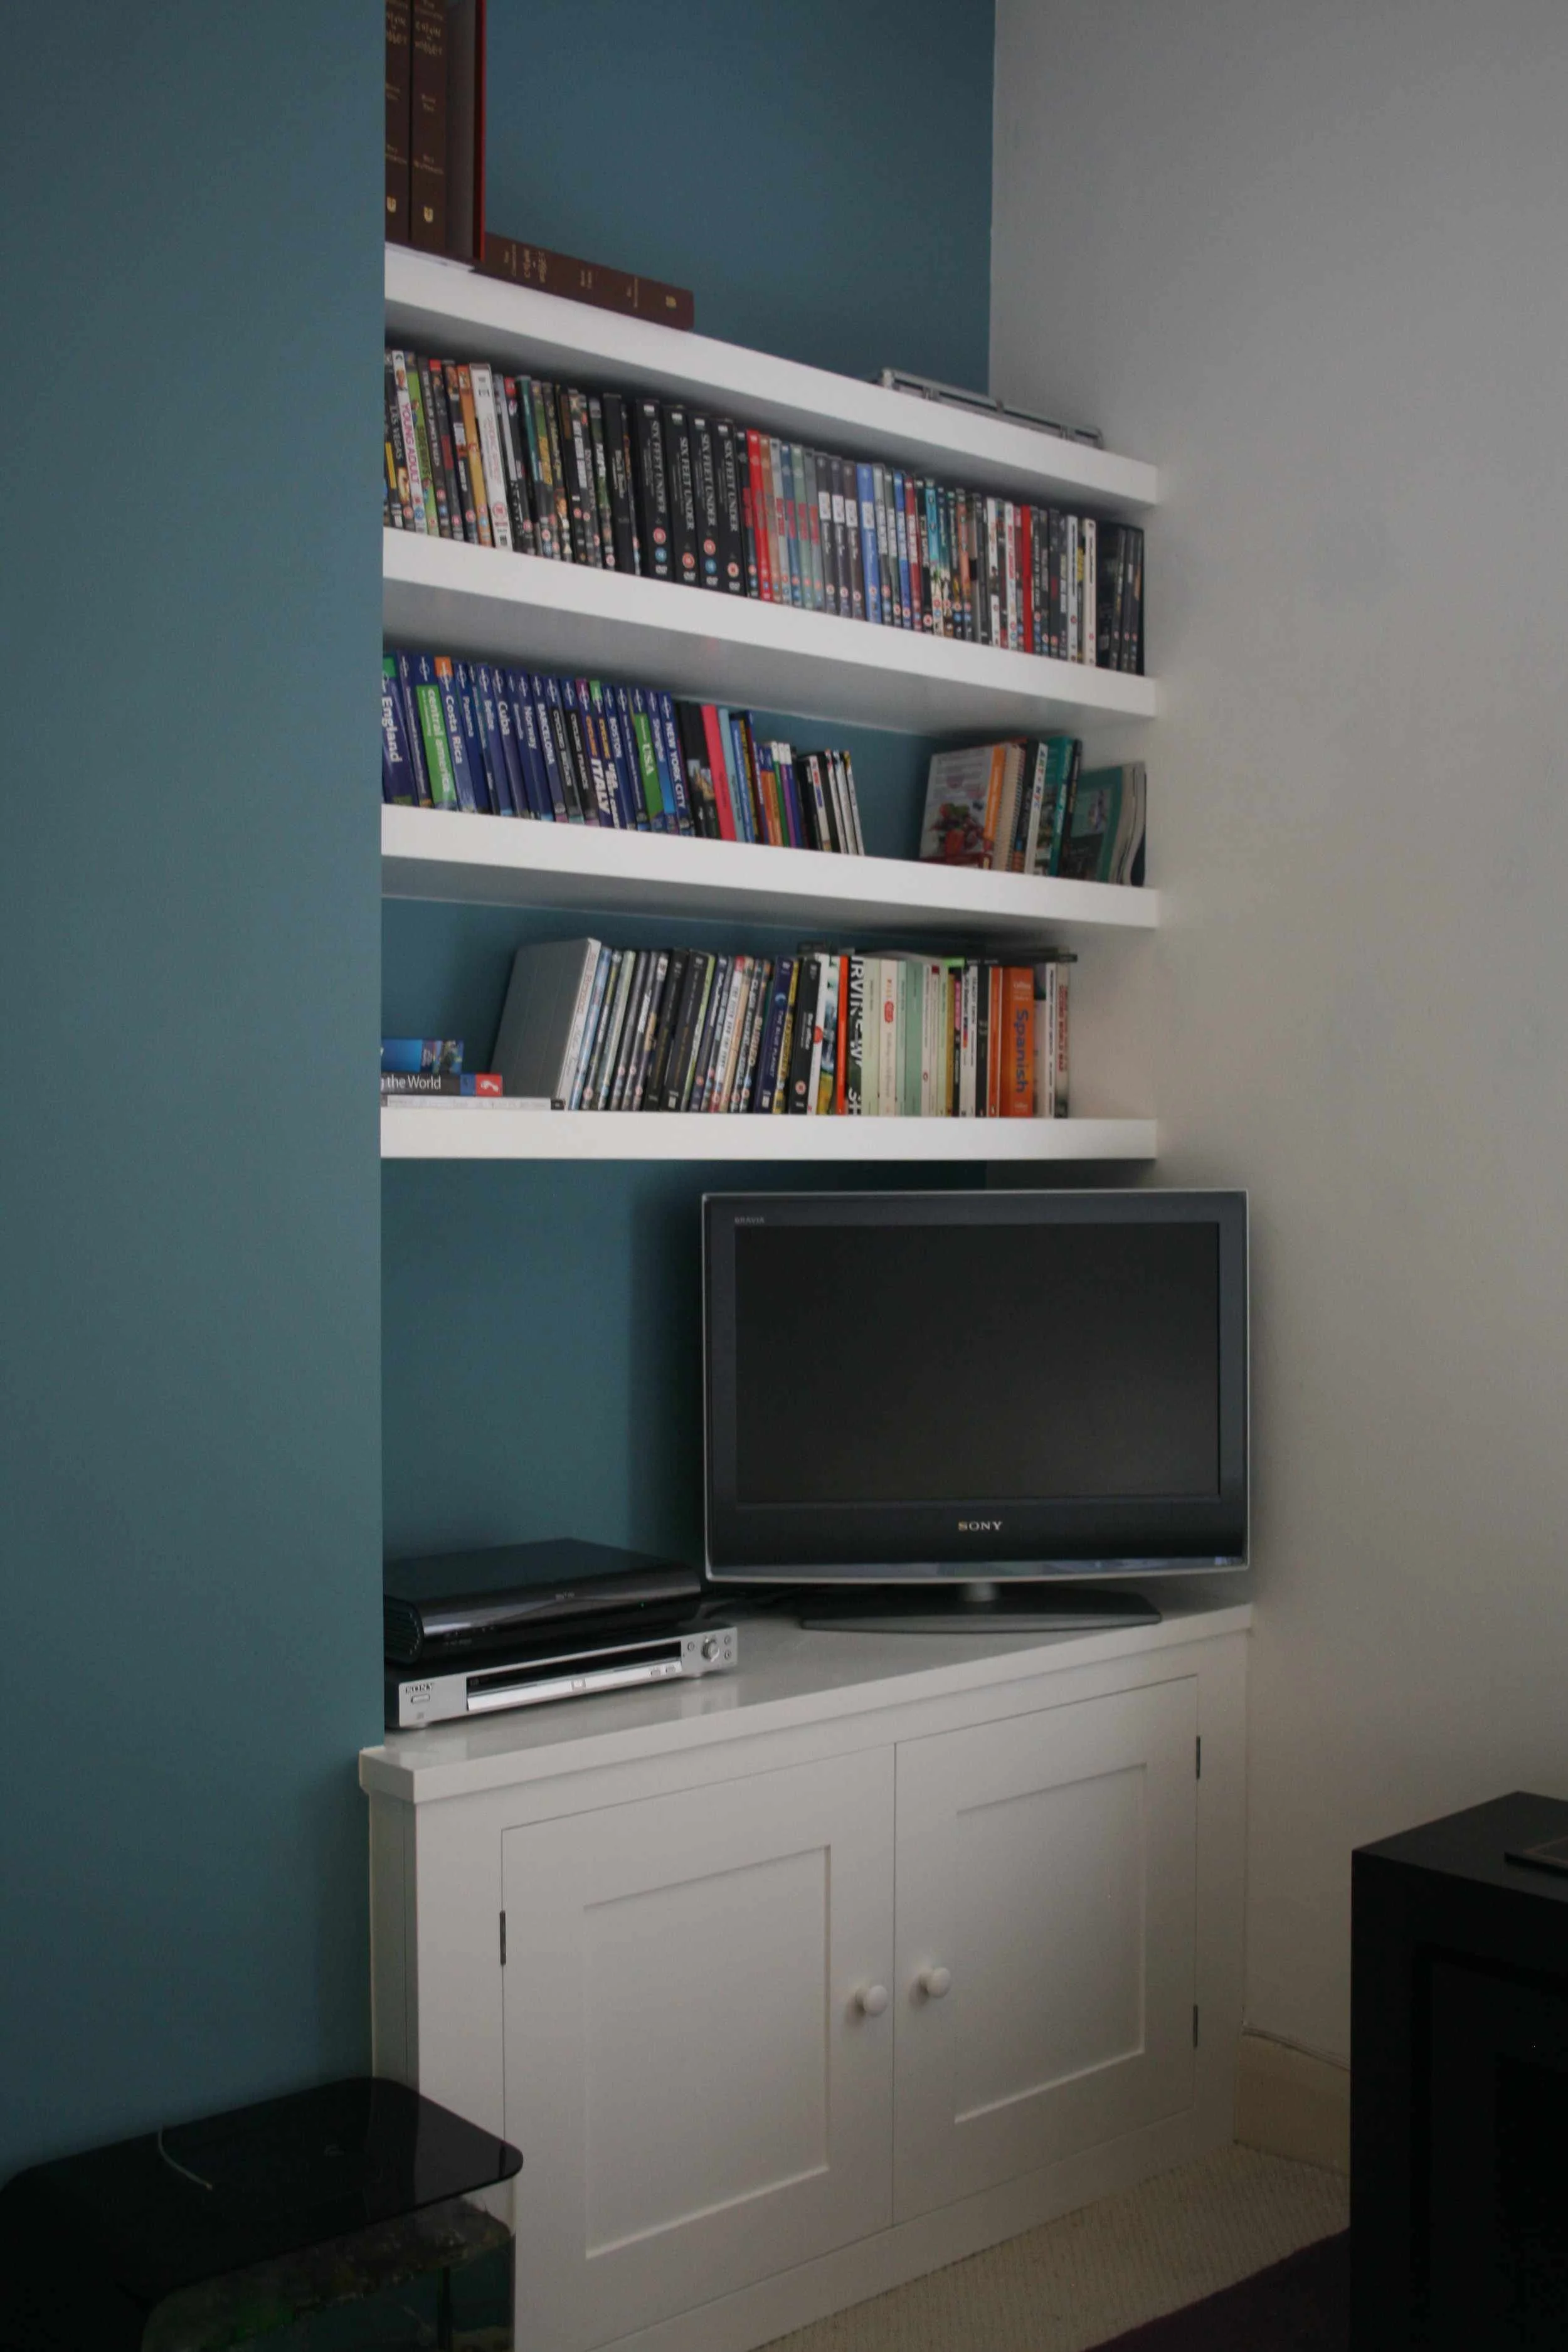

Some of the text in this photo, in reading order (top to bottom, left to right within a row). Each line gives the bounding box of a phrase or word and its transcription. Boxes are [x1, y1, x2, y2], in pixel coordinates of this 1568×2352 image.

[401, 403, 419, 485] YOUNG ADULT
[650, 420, 665, 514] SIX FEET UNDER
[681, 457, 691, 487] FEET
[701, 433, 716, 526] SIX FEET UNDER
[723, 440, 738, 532] SIX FEET UNDER
[684, 489, 694, 530] UNDER
[378, 696, 403, 763] England
[445, 694, 464, 764] Costa Rica
[462, 695, 475, 738] Panama
[483, 699, 496, 731] Belize
[497, 700, 512, 736] Cuba
[523, 704, 538, 750] Norway
[537, 702, 554, 765] BARCELONA
[553, 709, 565, 748] CYCLING
[570, 712, 581, 751] CYCLING
[426, 687, 452, 792] central america
[608, 716, 622, 758] BOSTON
[642, 742, 655, 775] USA
[651, 718, 665, 763] Shanghai
[585, 714, 610, 816] CYCLING ITALY
[608, 762, 618, 790] USA
[665, 721, 686, 809] NEW YORK CITY
[769, 1047, 778, 1078] PLANET
[1014, 1009, 1029, 1093] Spanish
[386, 1074, 442, 1089] the World
[734, 1215, 765, 1226] BRAVIA
[957, 1520, 1003, 1532] SONY
